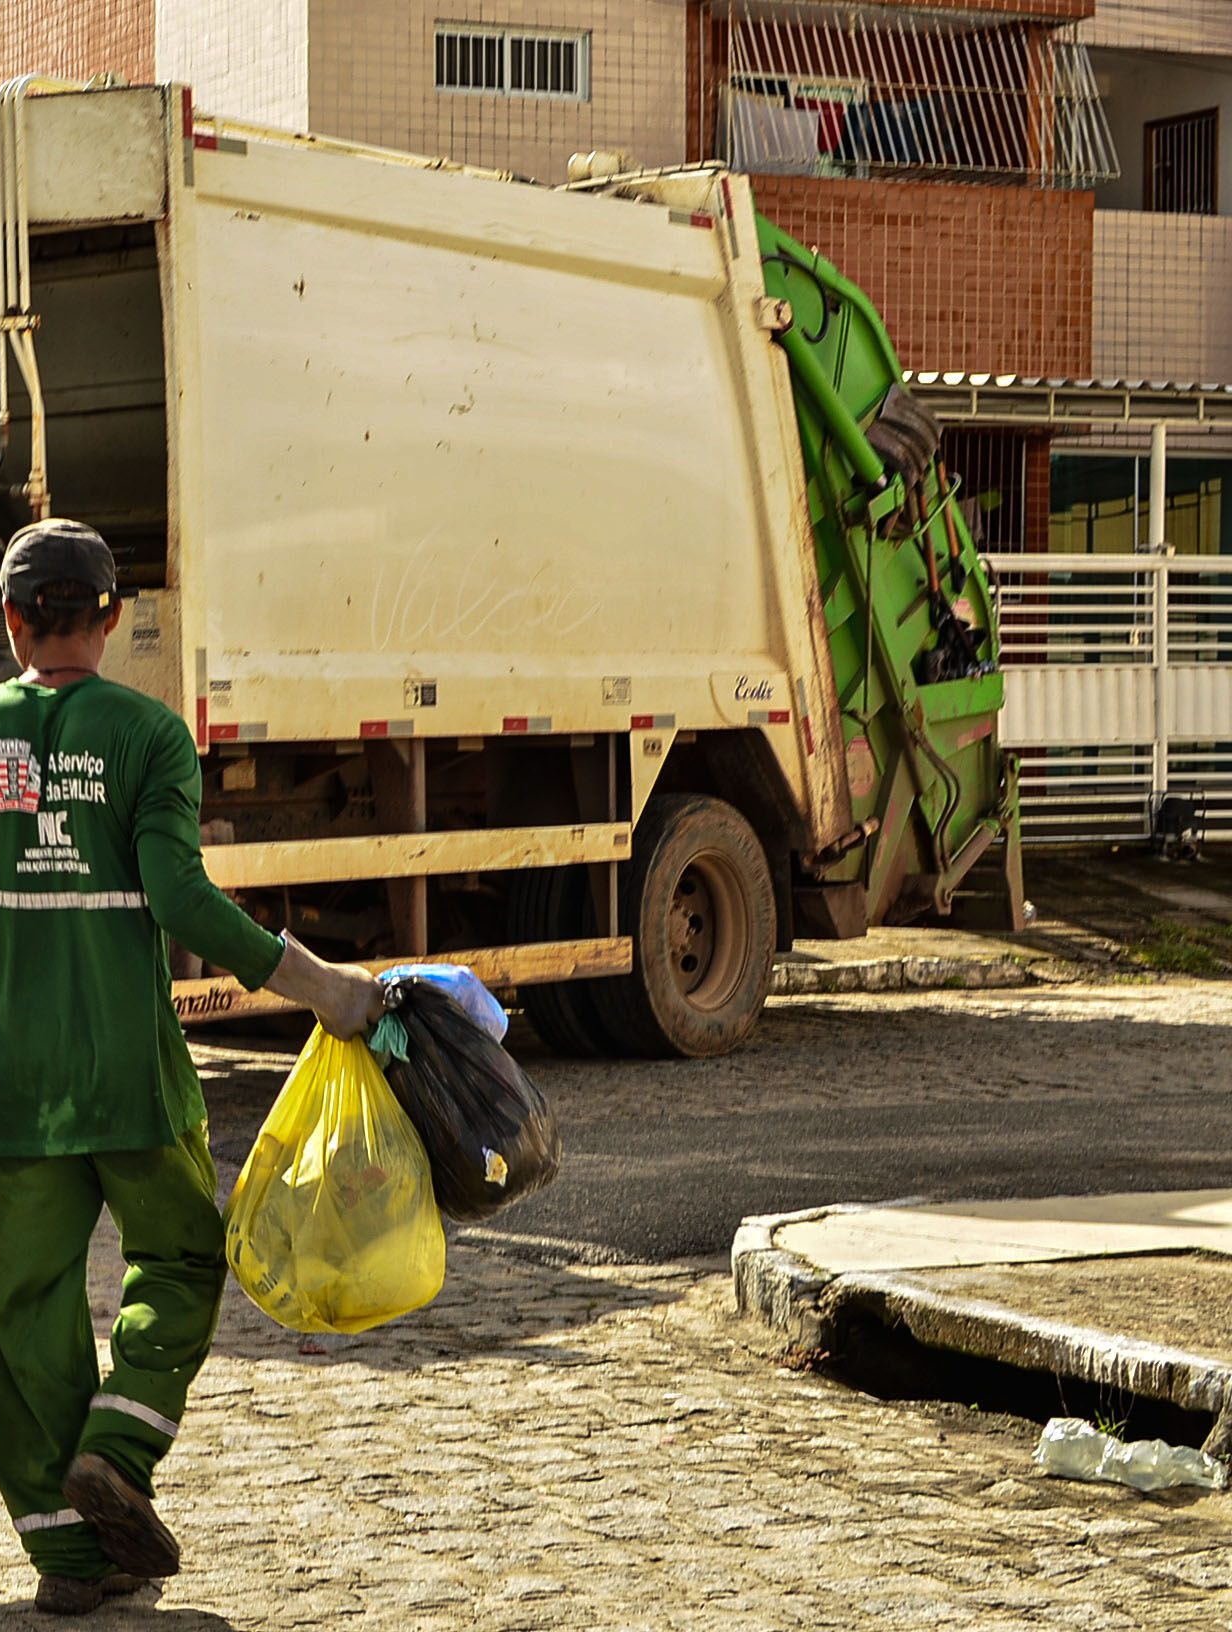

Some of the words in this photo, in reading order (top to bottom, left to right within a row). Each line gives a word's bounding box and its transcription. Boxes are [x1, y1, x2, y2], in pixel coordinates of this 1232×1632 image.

[48, 752, 57, 774] A
[58, 750, 104, 778] Serviço
[37, 810, 72, 846] NC
